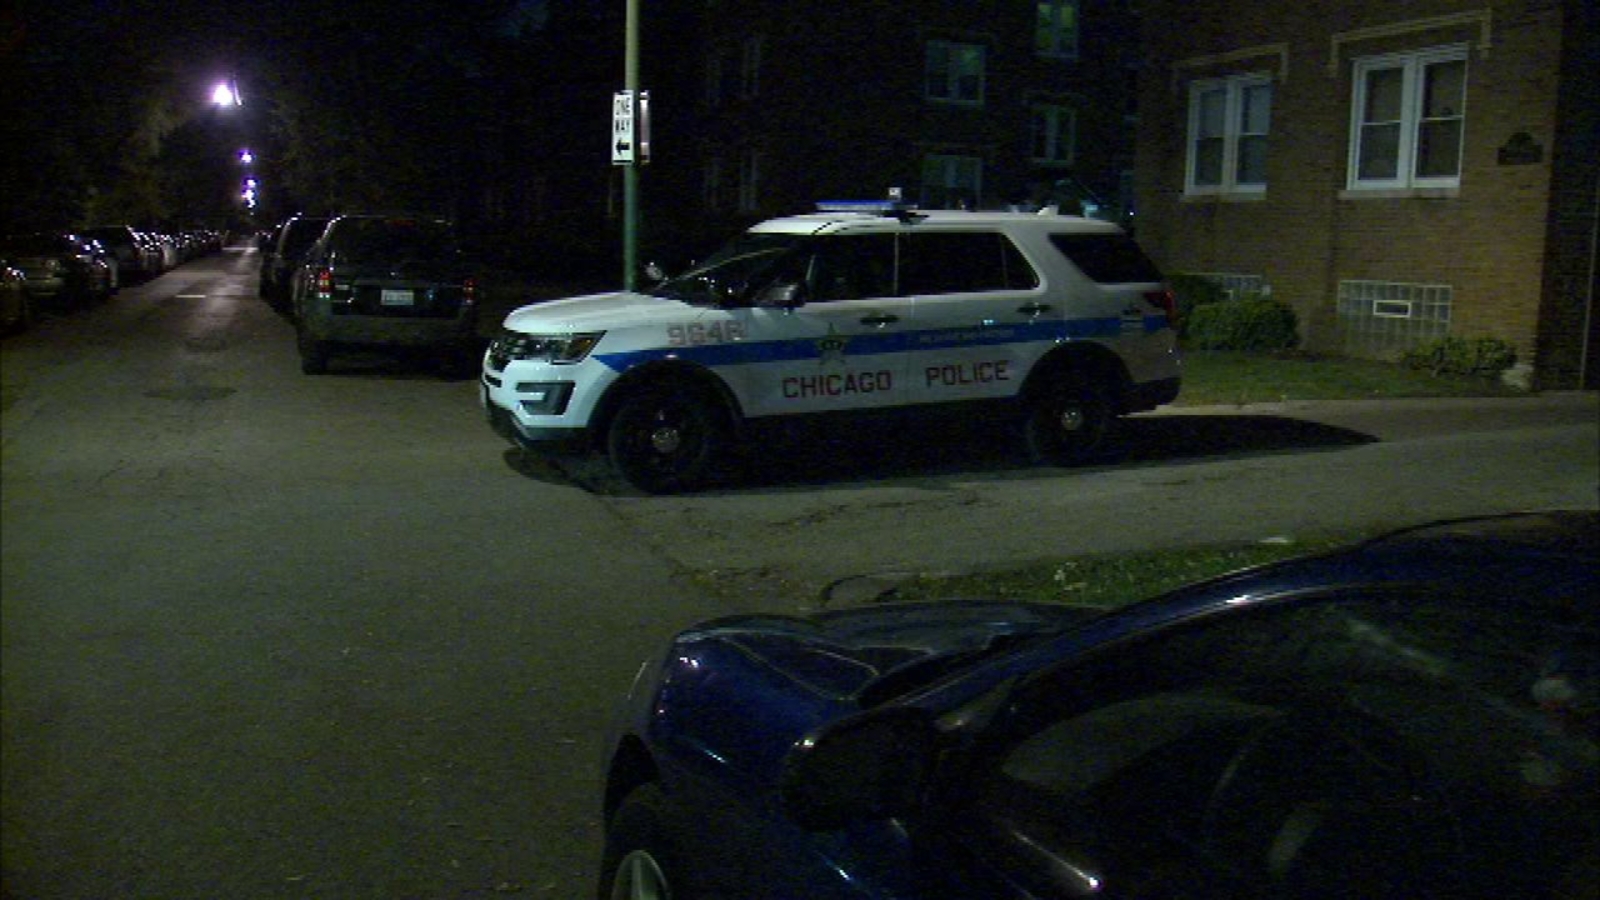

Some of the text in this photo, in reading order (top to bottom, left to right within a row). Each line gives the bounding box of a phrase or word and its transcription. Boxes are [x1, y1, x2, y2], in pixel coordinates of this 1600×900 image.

[614, 96, 631, 116] ONE
[614, 118, 631, 134] WAY
[782, 359, 1010, 399] CHICAGO POLICE
